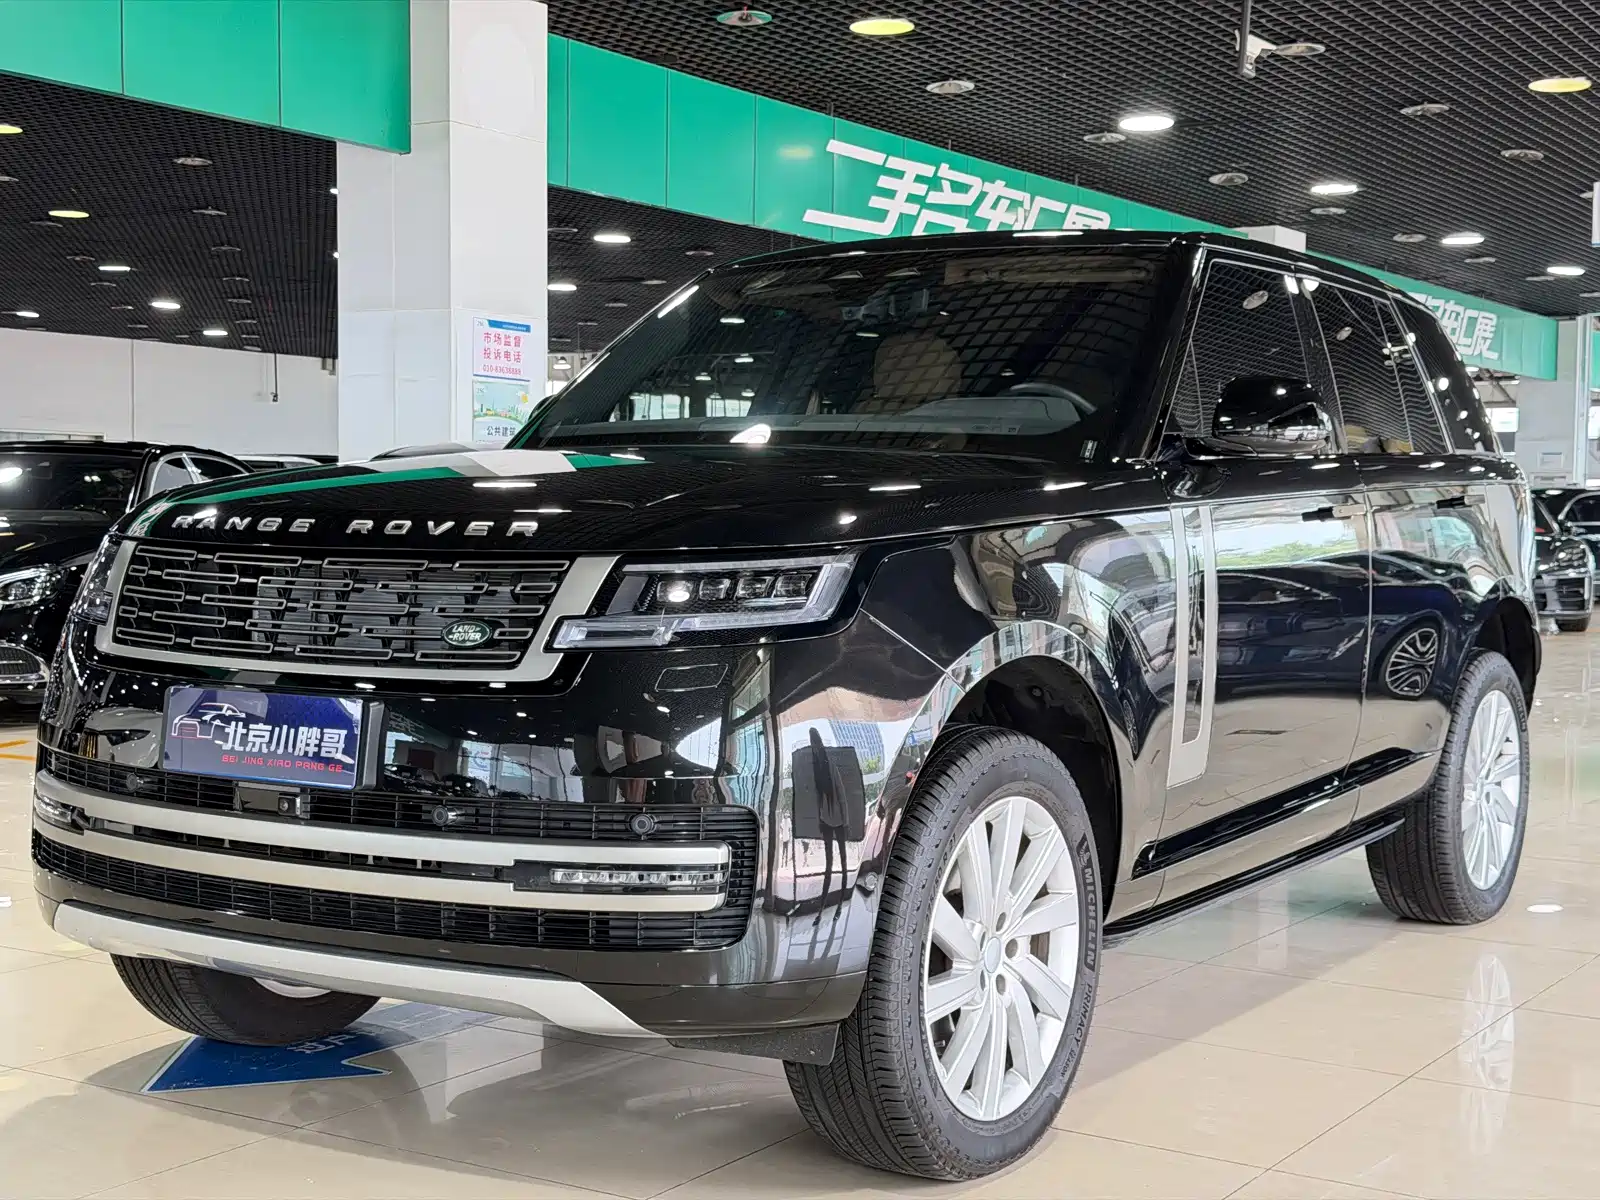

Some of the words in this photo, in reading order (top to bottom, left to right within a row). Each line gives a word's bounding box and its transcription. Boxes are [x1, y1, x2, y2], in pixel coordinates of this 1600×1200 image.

[484, 332, 521, 347] 市场监督
[484, 347, 522, 363] 投诉电话
[171, 514, 316, 533] RANGE
[346, 519, 539, 537] ROVER
[452, 625, 476, 633] LAND
[453, 632, 481, 640] ROVER
[221, 721, 348, 757] 北京小胖哥
[222, 755, 238, 763] BEI
[242, 756, 264, 765] JING
[267, 758, 292, 768] XIAO
[295, 760, 325, 770] PANG
[328, 763, 344, 772] GE
[1084, 867, 1097, 966] MICHELIN
[1073, 983, 1093, 1047] PRIMACY
